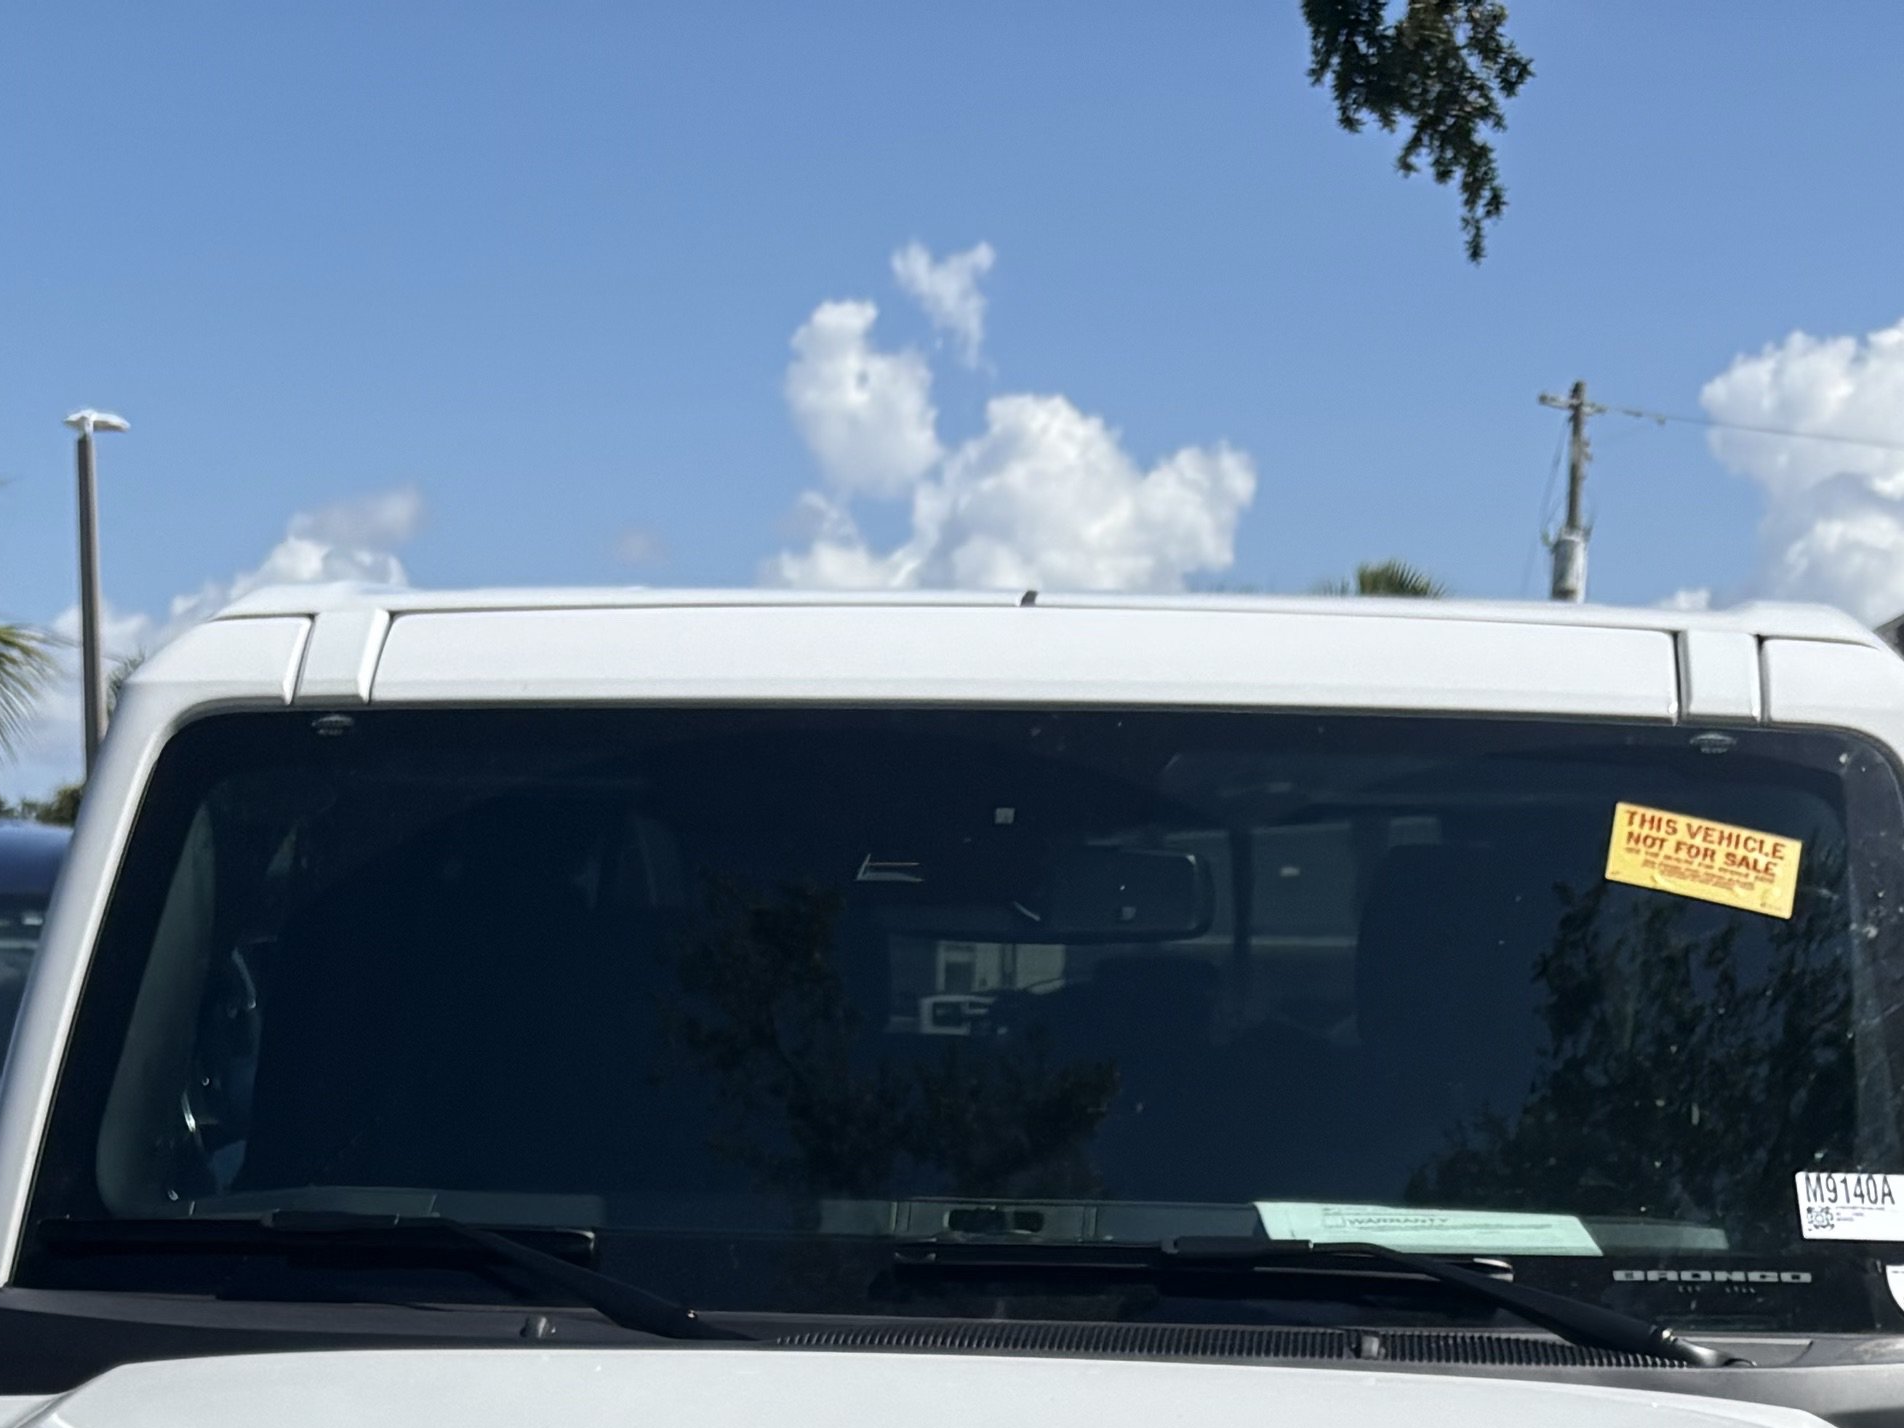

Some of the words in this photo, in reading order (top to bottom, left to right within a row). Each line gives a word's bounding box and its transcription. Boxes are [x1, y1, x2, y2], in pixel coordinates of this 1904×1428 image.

[1626, 810, 1678, 836] THIS
[1686, 822, 1786, 861] VEHICLE
[1626, 831, 1666, 851] NOT
[1674, 841, 1716, 862] FOR
[1724, 852, 1778, 876] SALE
[1805, 1173, 1896, 1205] M9140A
[1613, 1270, 1812, 1283] BRONCO
